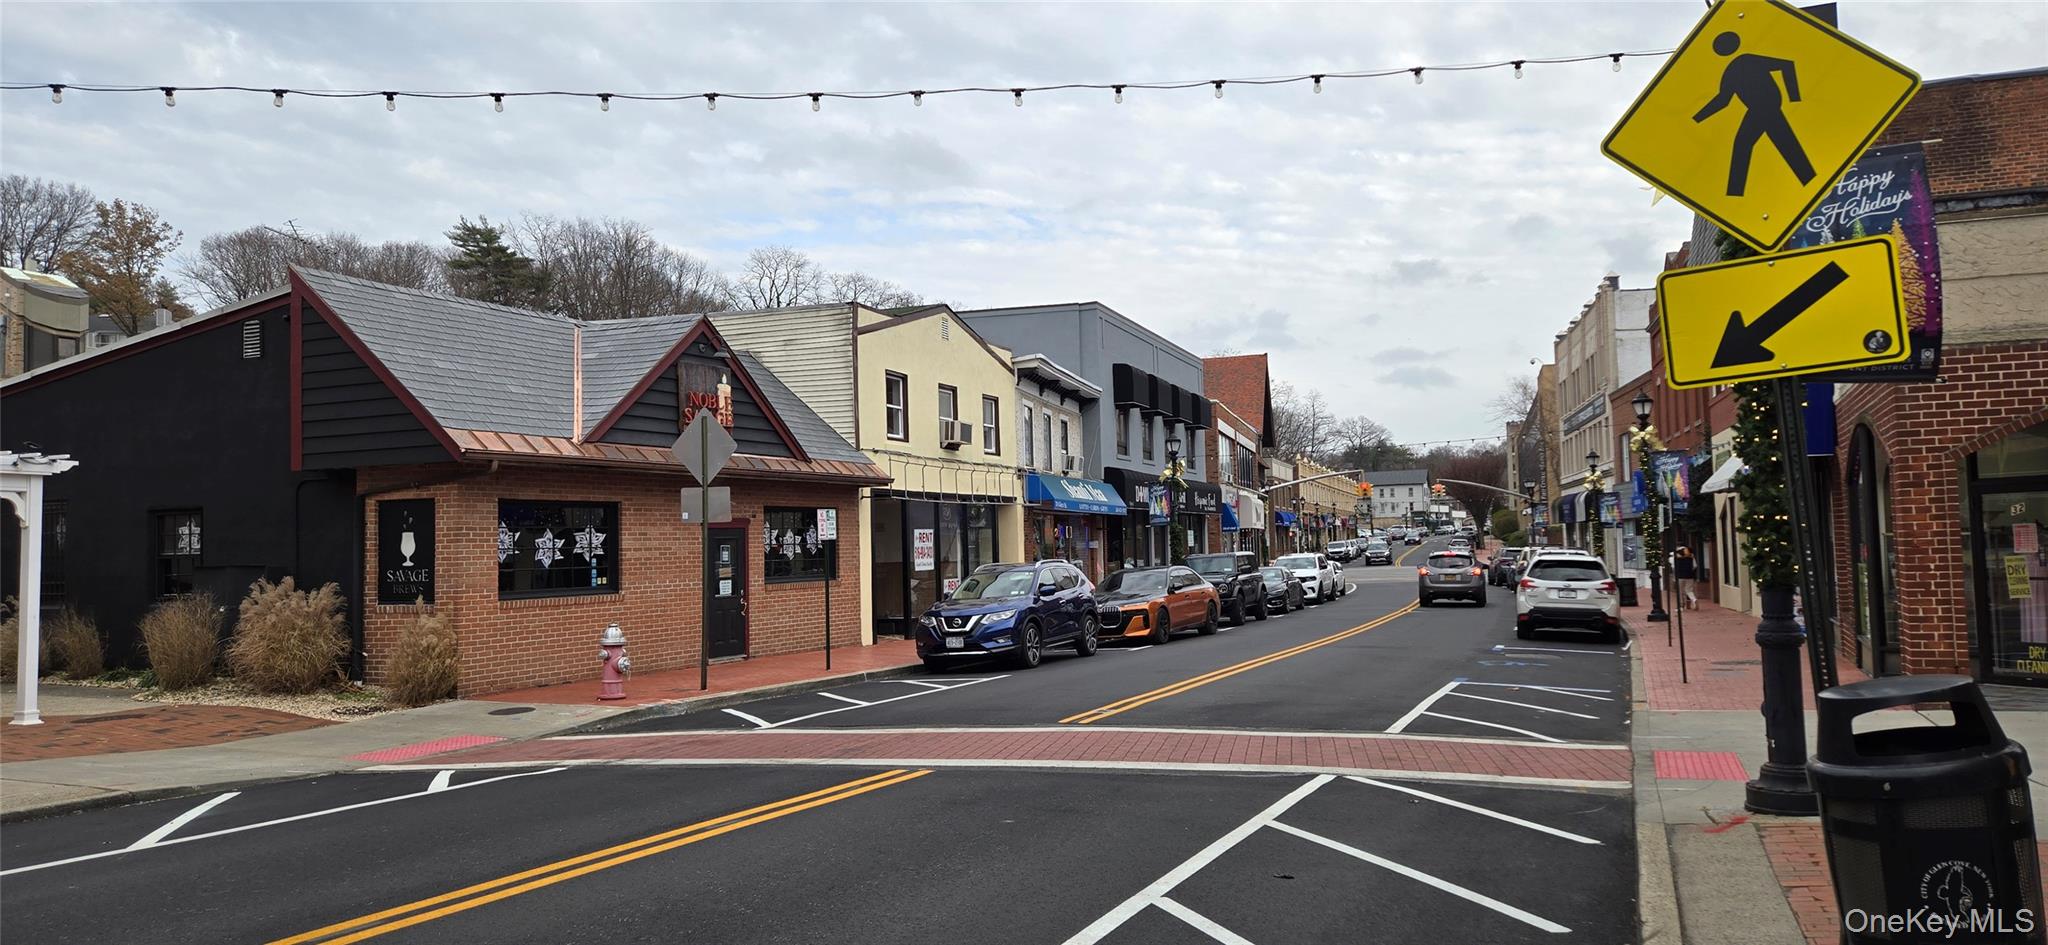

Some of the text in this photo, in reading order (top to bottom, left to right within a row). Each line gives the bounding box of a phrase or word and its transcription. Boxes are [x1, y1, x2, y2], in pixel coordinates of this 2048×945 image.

[1806, 190, 1913, 233] Holidays
[1870, 363, 1915, 372] DISTRICT
[687, 391, 734, 412] NOBLE
[684, 407, 735, 427] SGE
[2010, 503, 2025, 515] 32
[919, 532, 933, 543] RENT
[387, 569, 430, 582] SAVAGE
[2007, 565, 2027, 576] DRY
[393, 584, 424, 594] BREWS
[2010, 587, 2031, 596] SERVICE
[2029, 646, 2046, 659] DRY
